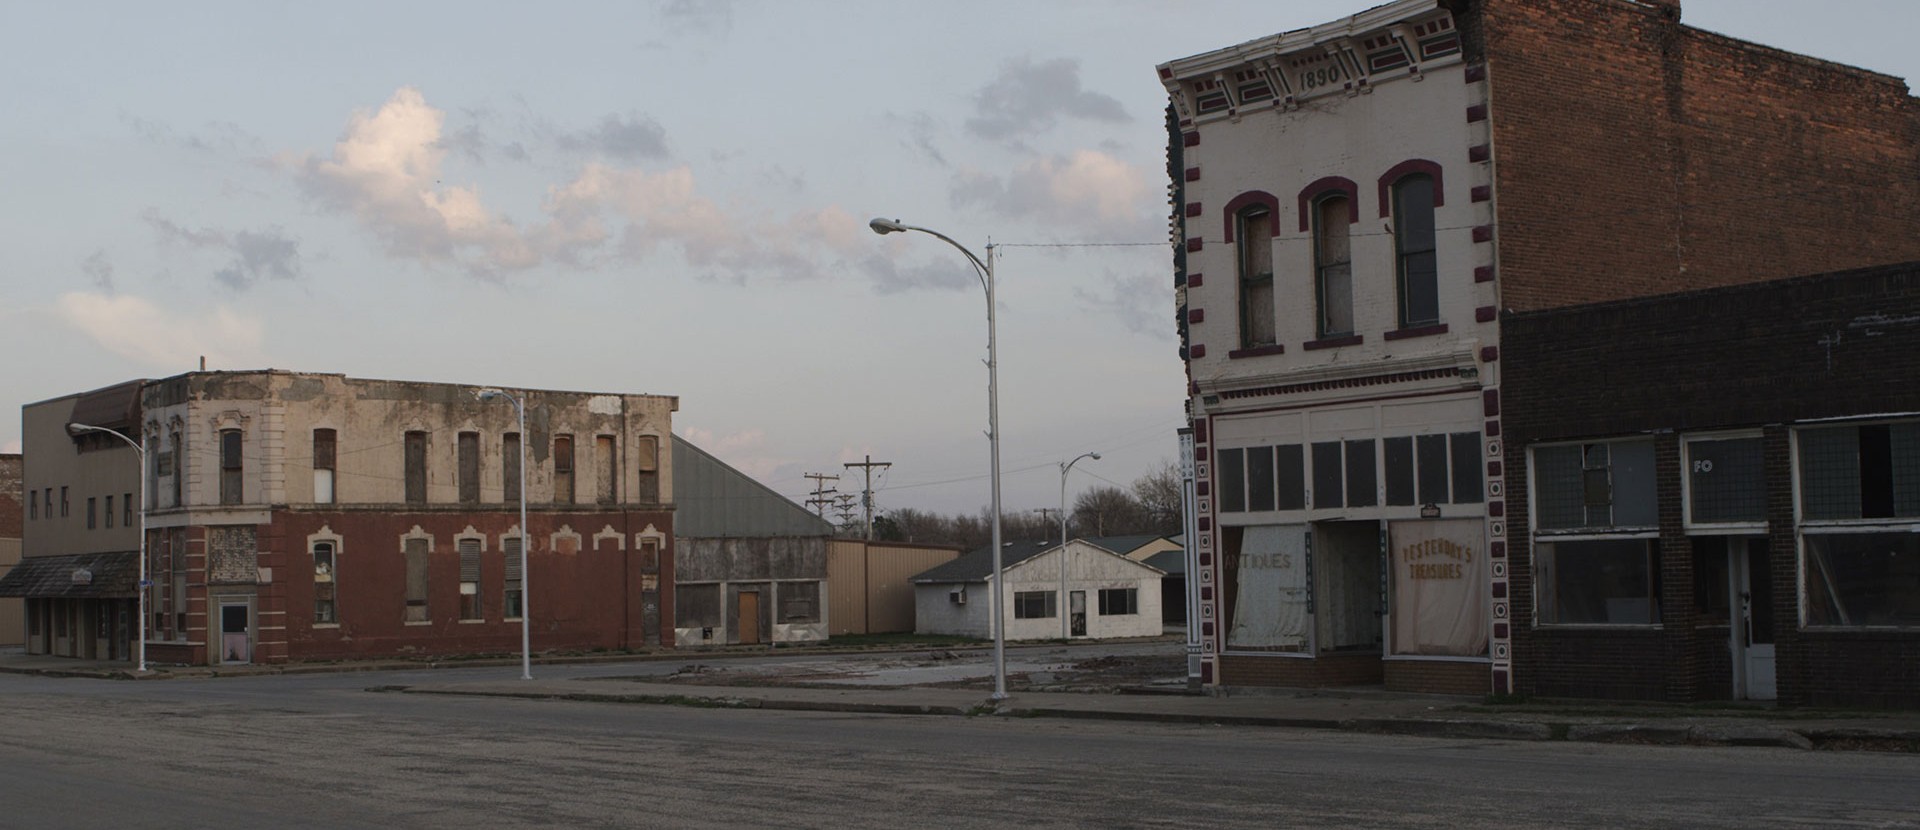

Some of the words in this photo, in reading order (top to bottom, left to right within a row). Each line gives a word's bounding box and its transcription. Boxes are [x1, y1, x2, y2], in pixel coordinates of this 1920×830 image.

[1300, 65, 1339, 90] 1890
[1694, 460, 1712, 472] FO
[1224, 553, 1290, 569] ANTIQUES
[1410, 564, 1462, 579] TREASURES
